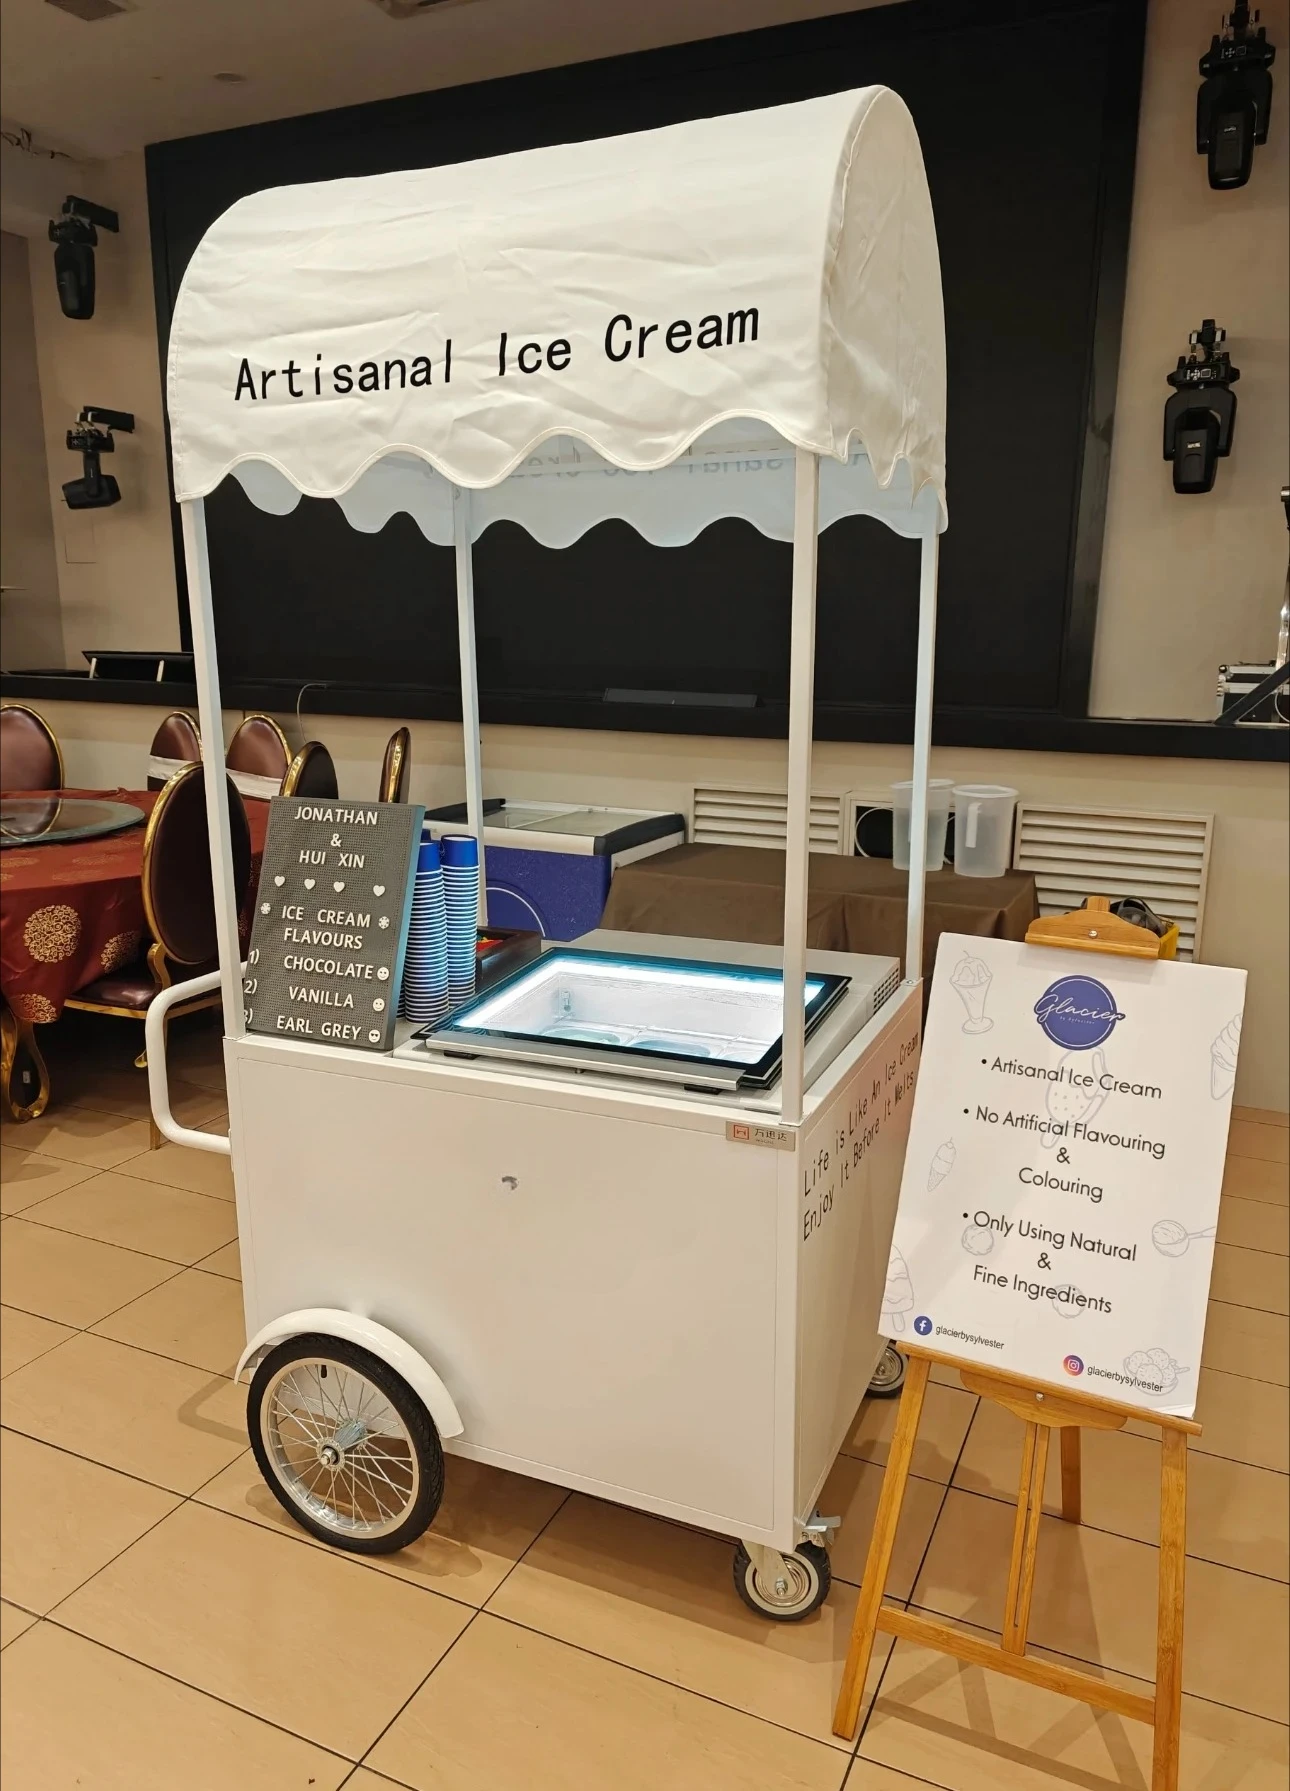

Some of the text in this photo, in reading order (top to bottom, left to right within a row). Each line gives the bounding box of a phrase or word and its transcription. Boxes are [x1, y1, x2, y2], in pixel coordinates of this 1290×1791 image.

[234, 306, 760, 402] Artisanal Ice Cream
[295, 807, 378, 825] JONATHAN
[330, 833, 342, 847] &
[299, 850, 365, 869] HUI XIN
[281, 905, 371, 928] ICE CREAM
[284, 927, 363, 950] FLAVOURS
[249, 948, 374, 980] 1) CHOCOLATE
[243, 978, 354, 1008] 2) VANILLA
[1035, 993, 1124, 1023] Glacier
[276, 1015, 313, 1035] EARL
[321, 1022, 362, 1041] GREY
[990, 1056, 1163, 1100] Artisanal Ice Cream
[804, 1031, 919, 1197] Life is Like An Ice Cream
[976, 1105, 1166, 1160] No Artificial Flavouring
[803, 1184, 835, 1241] Enjoy
[840, 1160, 849, 1188] It
[853, 1118, 880, 1169] Before
[883, 1098, 891, 1121] It
[1056, 1146, 1071, 1165] &
[1018, 1166, 1104, 1204] Colouring
[973, 1210, 1137, 1262] Only Using Natural
[1037, 1252, 1052, 1271] &
[973, 1264, 1112, 1314] Fine Ingredients
[935, 1324, 1005, 1351] glacierbysylvester
[1087, 1365, 1164, 1394] glacierbysylvester
